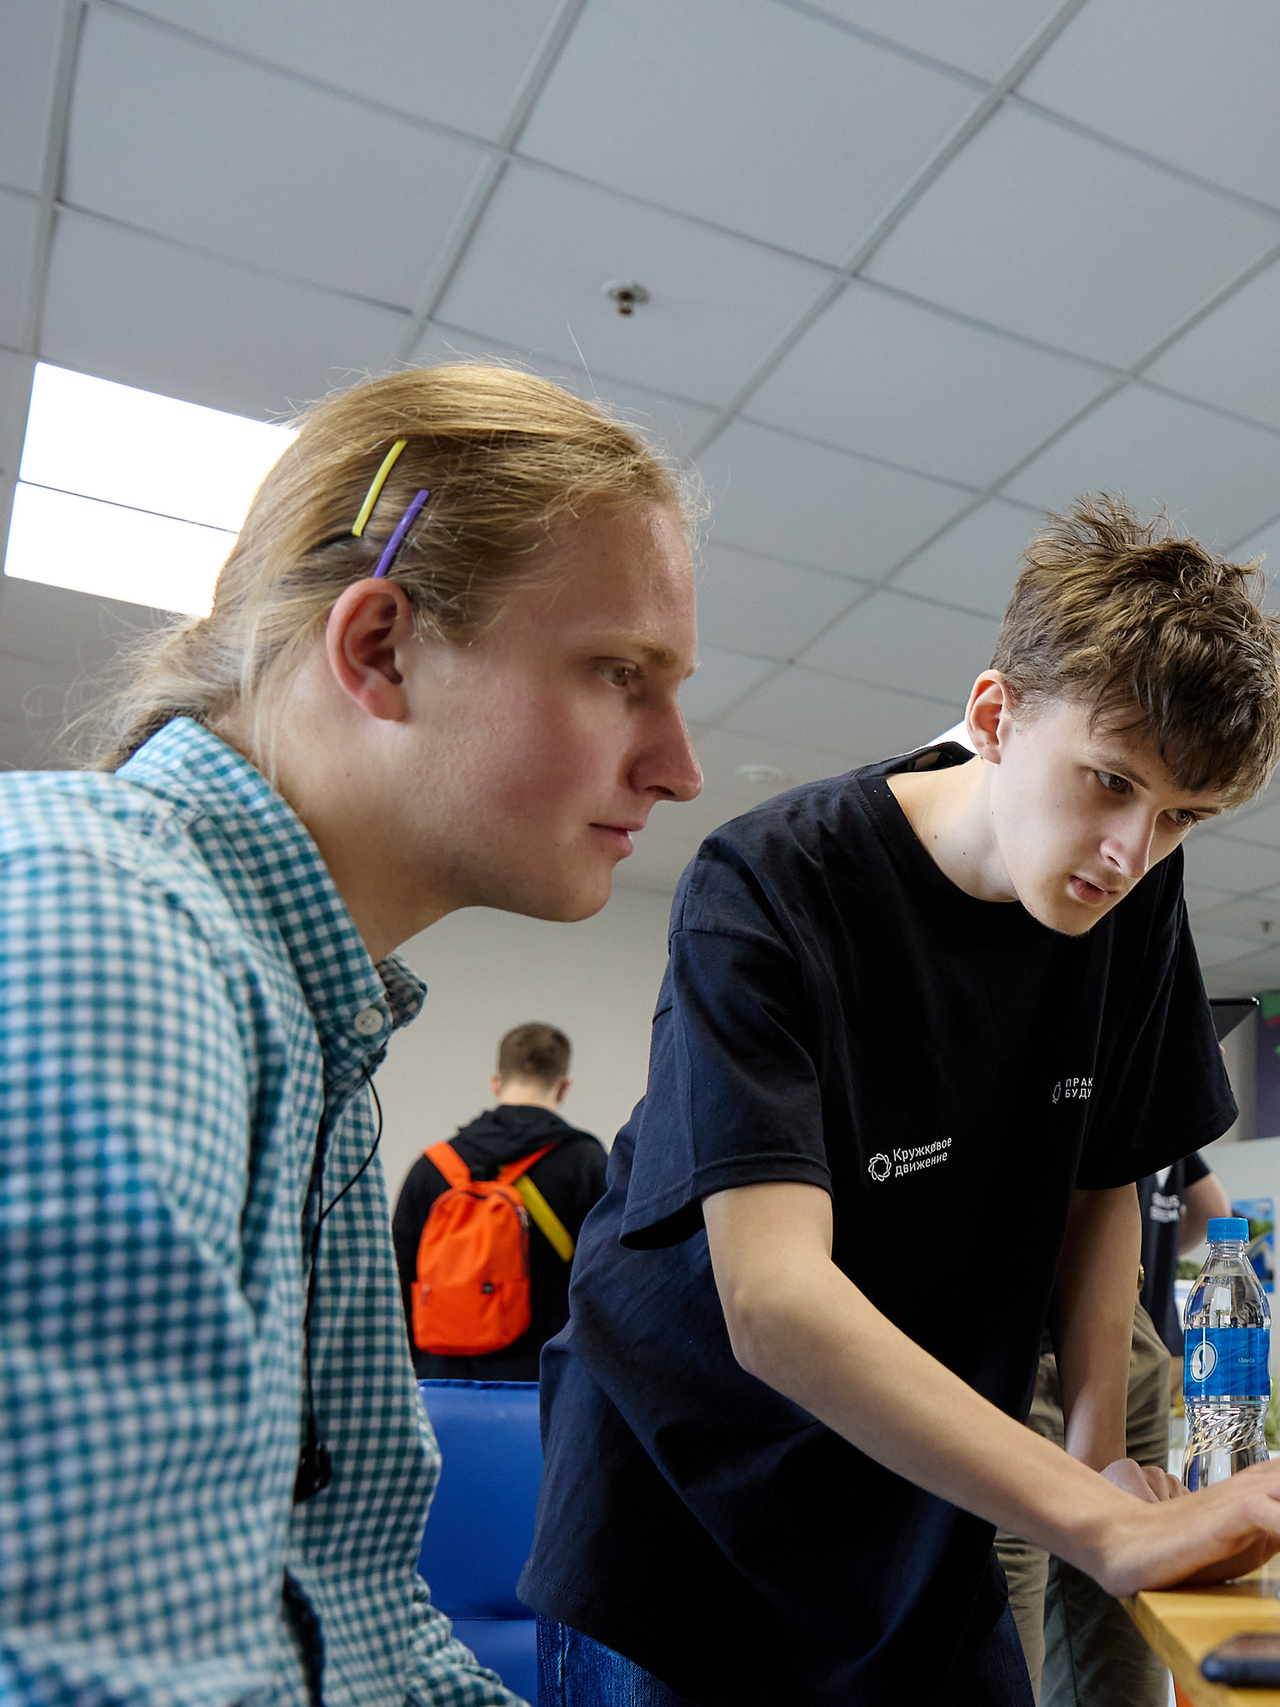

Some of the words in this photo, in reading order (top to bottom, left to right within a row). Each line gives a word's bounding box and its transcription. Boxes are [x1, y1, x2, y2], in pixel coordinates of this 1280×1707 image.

[1065, 1077, 1094, 1088] ПРАК
[892, 1137, 952, 1163] Кружковое
[894, 1152, 948, 1178] движение
